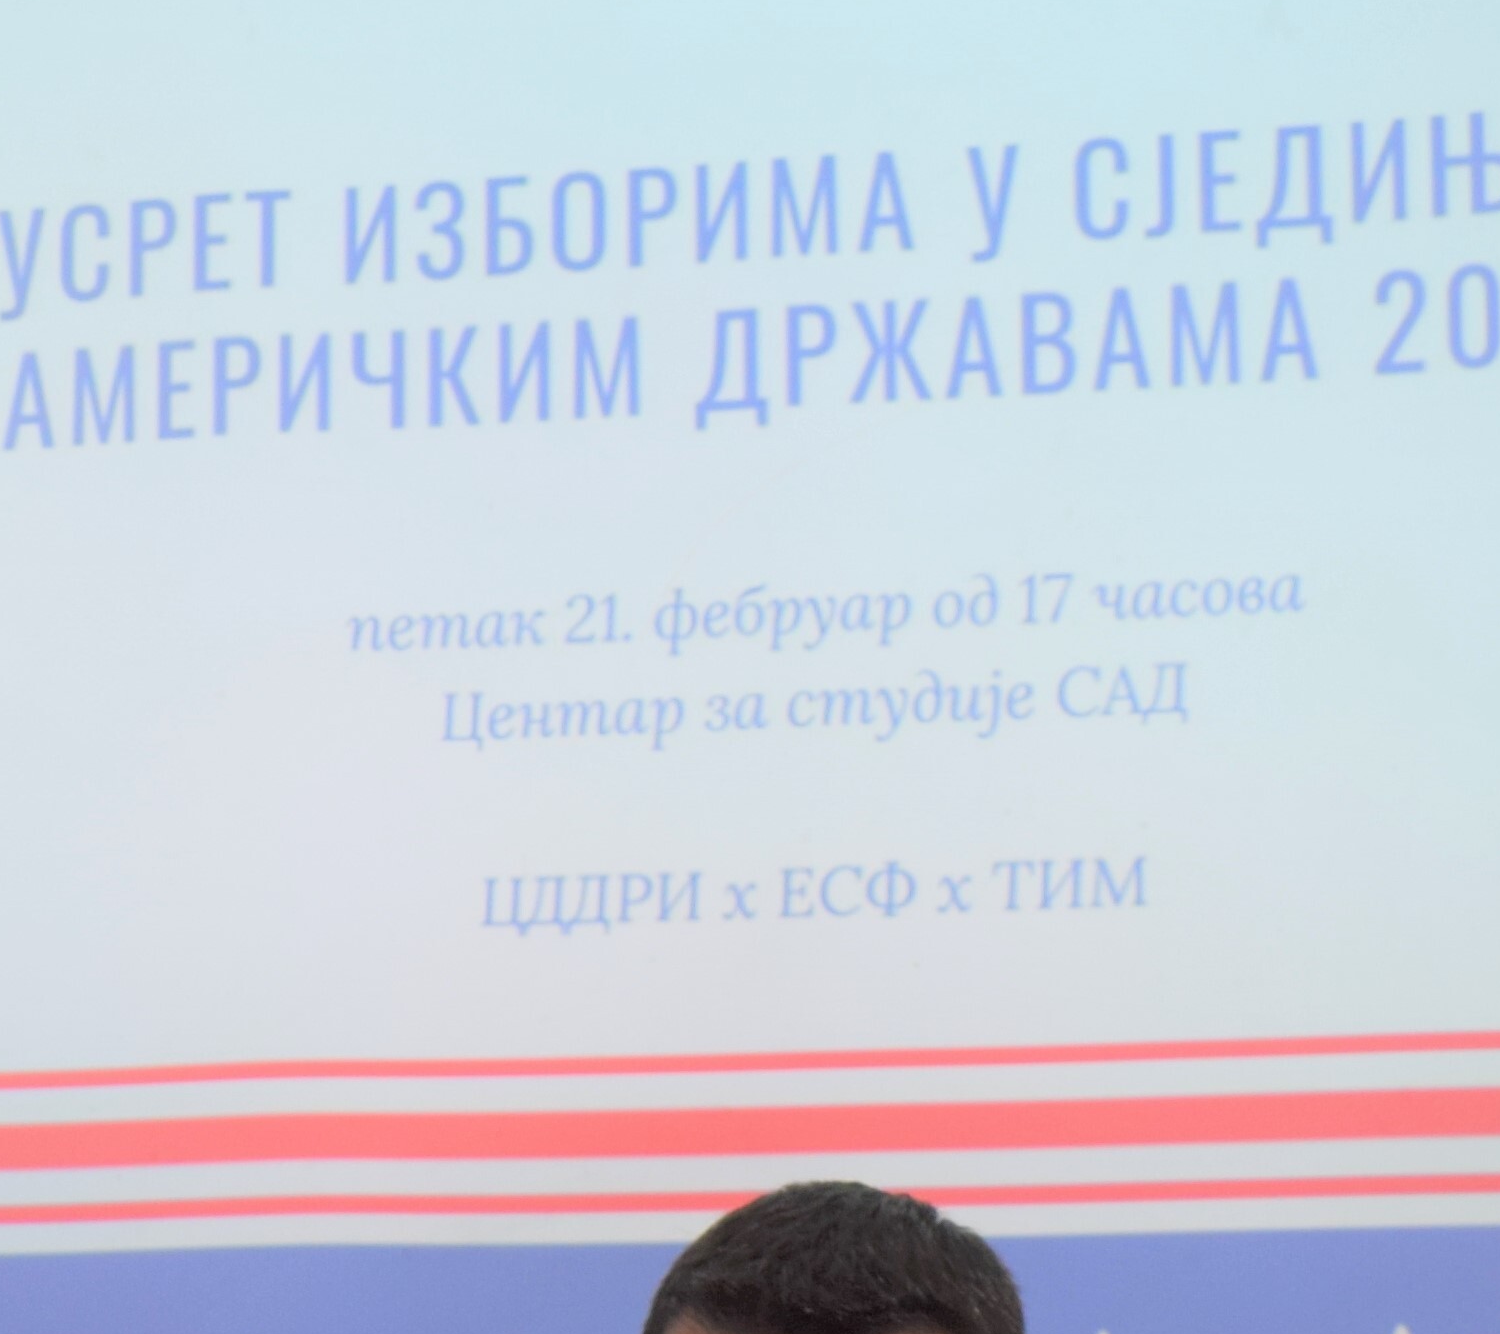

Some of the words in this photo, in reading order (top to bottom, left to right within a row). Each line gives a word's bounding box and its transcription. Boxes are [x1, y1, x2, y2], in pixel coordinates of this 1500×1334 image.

[345, 150, 916, 285] ИЗБОРИМА
[968, 143, 1020, 262] У
[3, 315, 640, 450] АМЕРИЧКИМ
[695, 276, 1321, 430] ДРЖАВАМА
[348, 609, 545, 651] петак
[564, 591, 633, 645] 21.
[652, 583, 912, 657] фебруар
[932, 573, 999, 628] од
[1020, 573, 1075, 626] 17
[1093, 574, 1307, 621] часова
[441, 691, 686, 751] Центар
[703, 691, 769, 733] за
[786, 668, 1036, 742] студије
[1055, 661, 1191, 725] САД
[481, 869, 704, 937] ЦДДРИ
[778, 859, 919, 919] ЕСФ
[991, 856, 1149, 912] ТИМ
